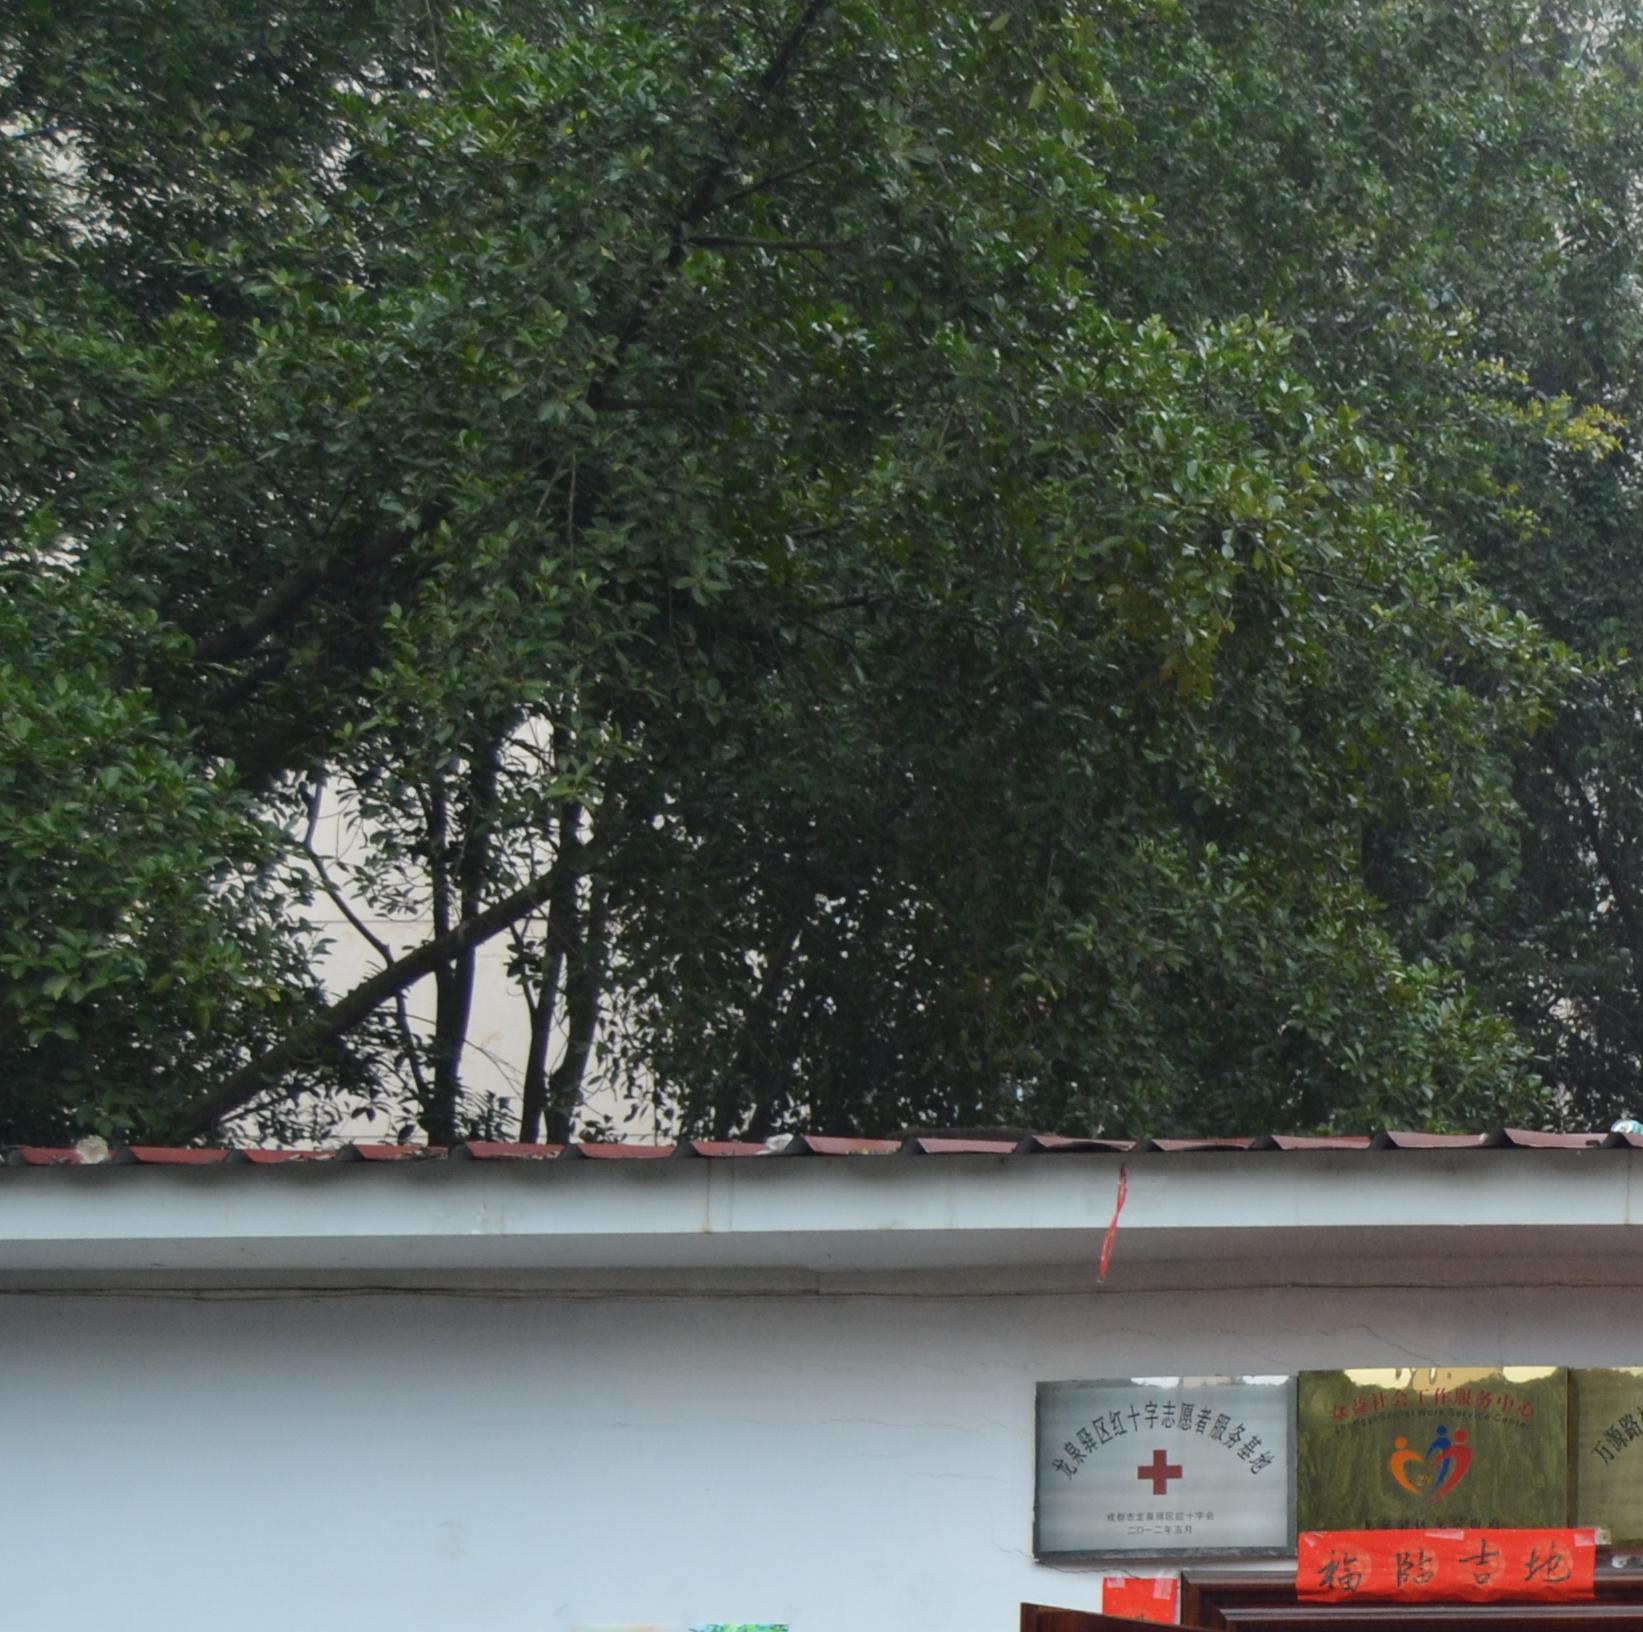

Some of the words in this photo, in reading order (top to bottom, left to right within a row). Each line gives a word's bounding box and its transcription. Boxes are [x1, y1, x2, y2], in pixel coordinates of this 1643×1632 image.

[1050, 1399, 1276, 1480] 龙泉驿区红十字志愿者服务基地
